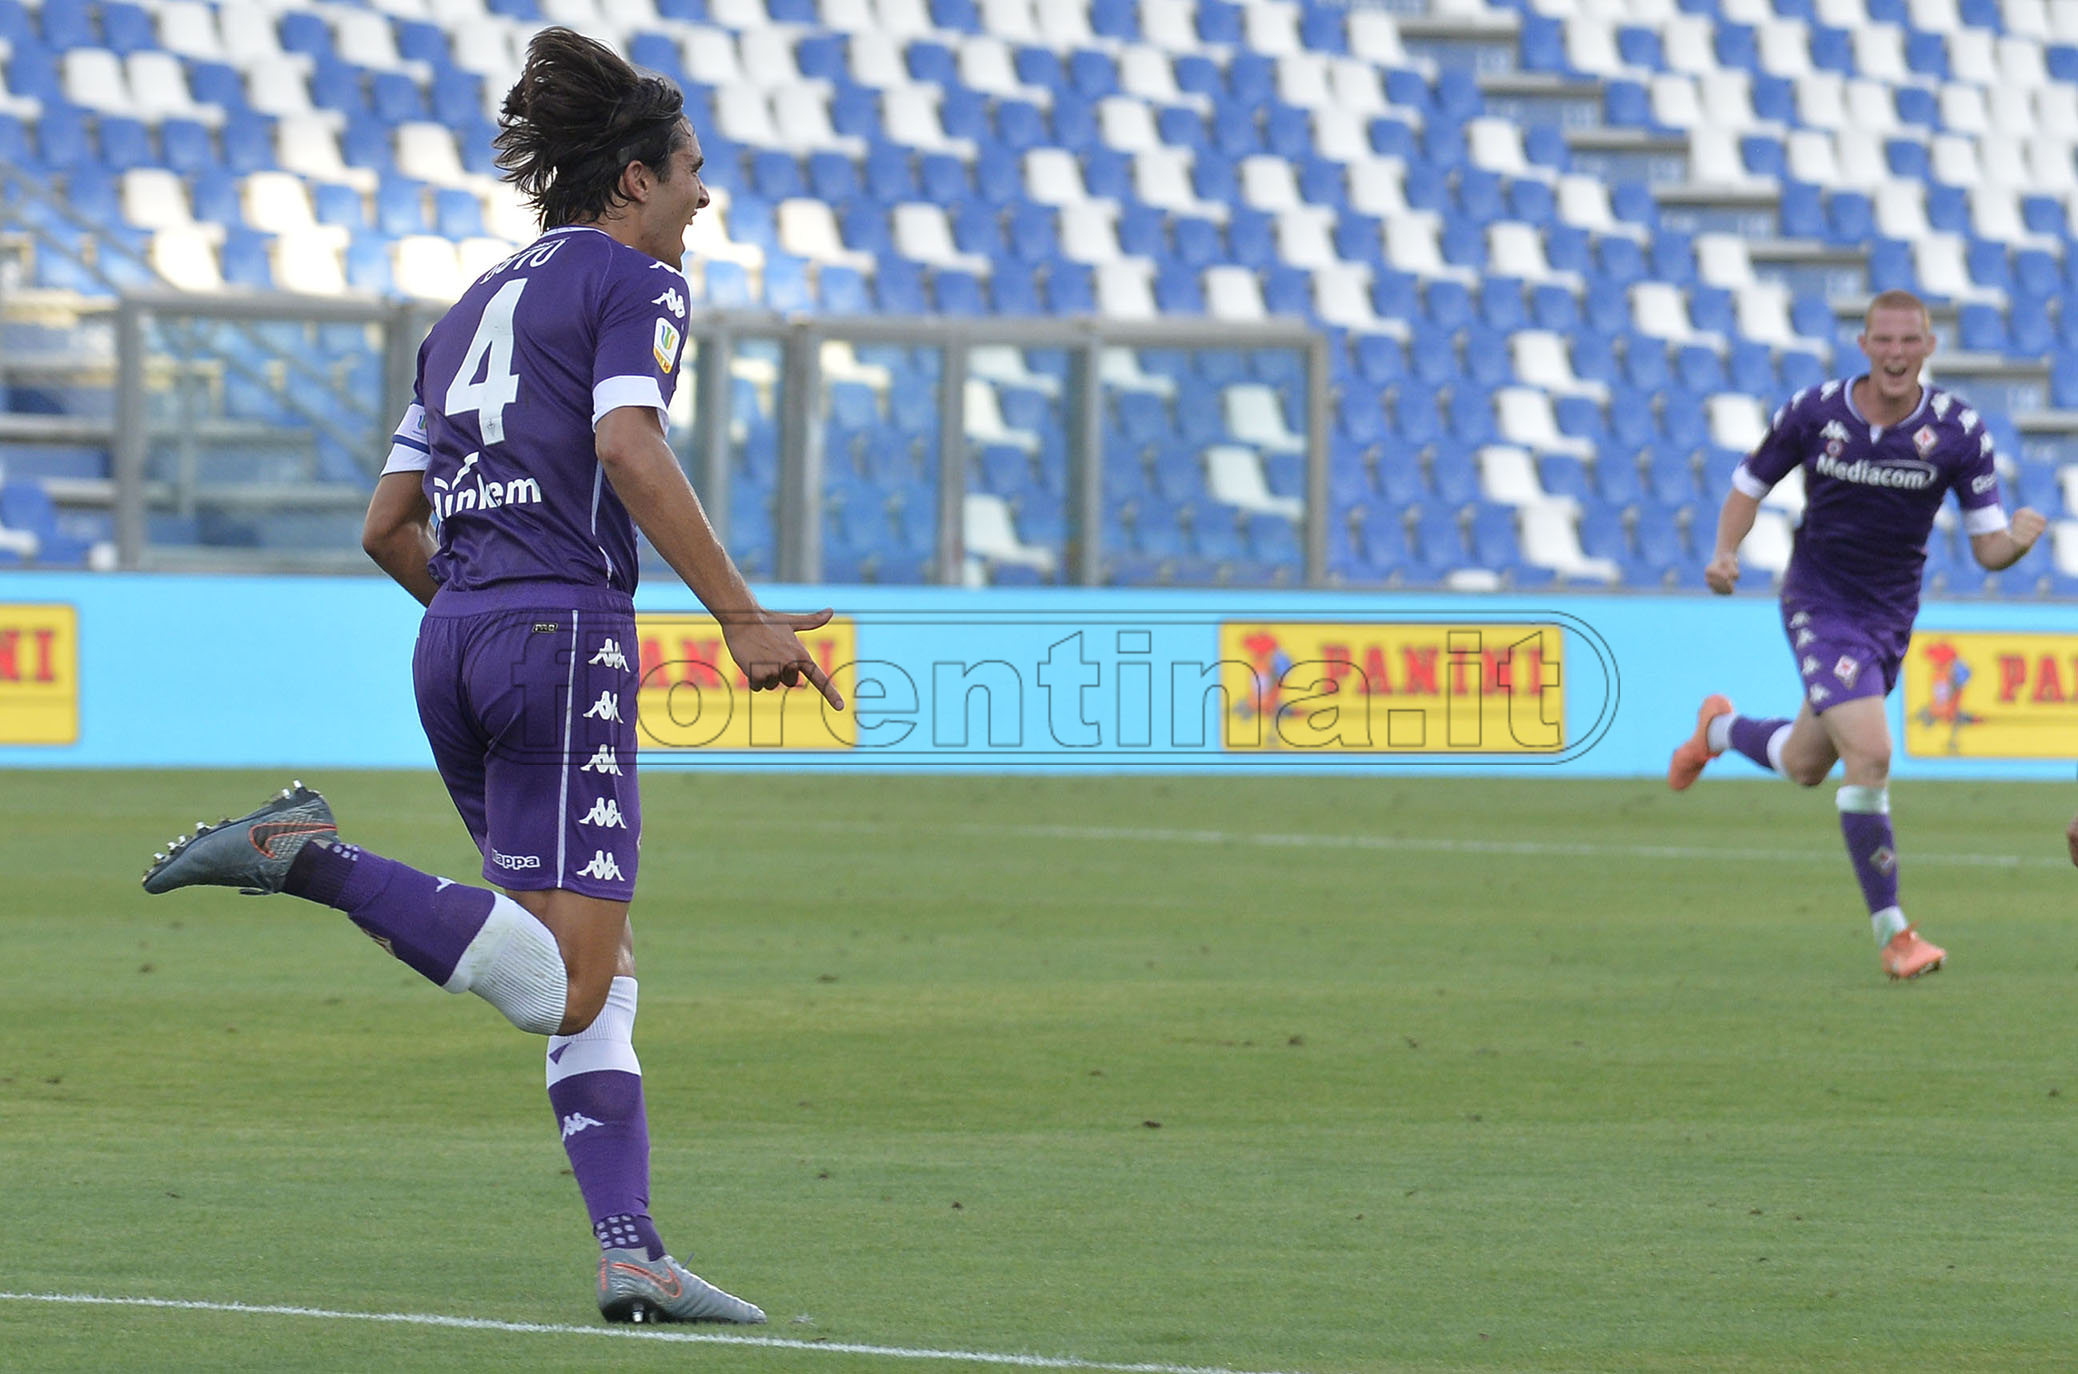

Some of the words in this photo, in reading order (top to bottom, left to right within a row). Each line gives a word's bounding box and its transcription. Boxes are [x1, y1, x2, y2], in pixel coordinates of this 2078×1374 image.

[445, 278, 540, 446] 4
[1816, 452, 1928, 489] Mediacom
[1321, 645, 1543, 696] PANINI
